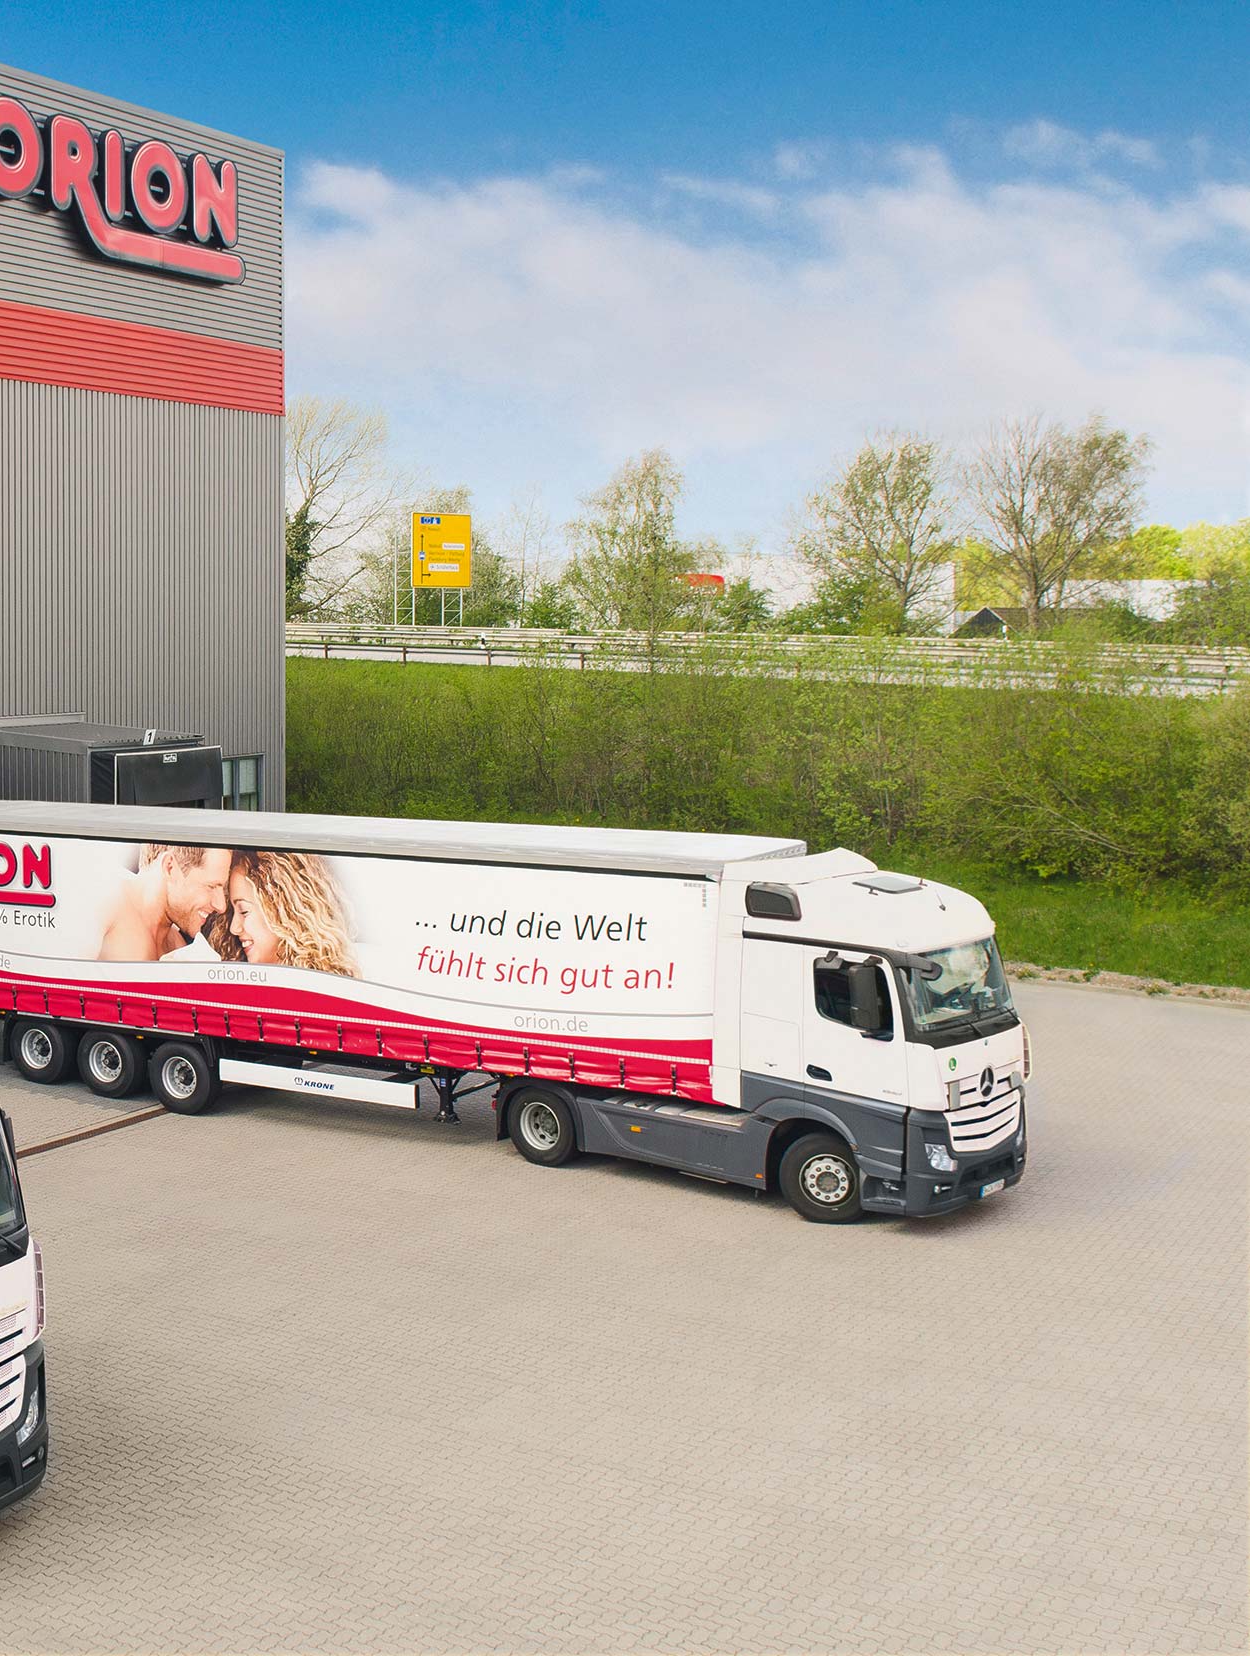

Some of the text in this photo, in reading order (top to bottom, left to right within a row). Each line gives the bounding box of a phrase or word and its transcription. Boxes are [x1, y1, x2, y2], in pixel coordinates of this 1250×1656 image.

[147, 731, 152, 742] 1
[13, 910, 56, 929] Erotik
[449, 910, 507, 936] und
[516, 911, 561, 940] die
[573, 913, 648, 942] Welt
[207, 966, 267, 983] orion.eu
[417, 945, 675, 995] fühlt sich gut an!
[513, 1012, 589, 1033] orion.de
[304, 1080, 335, 1090] KRONE
